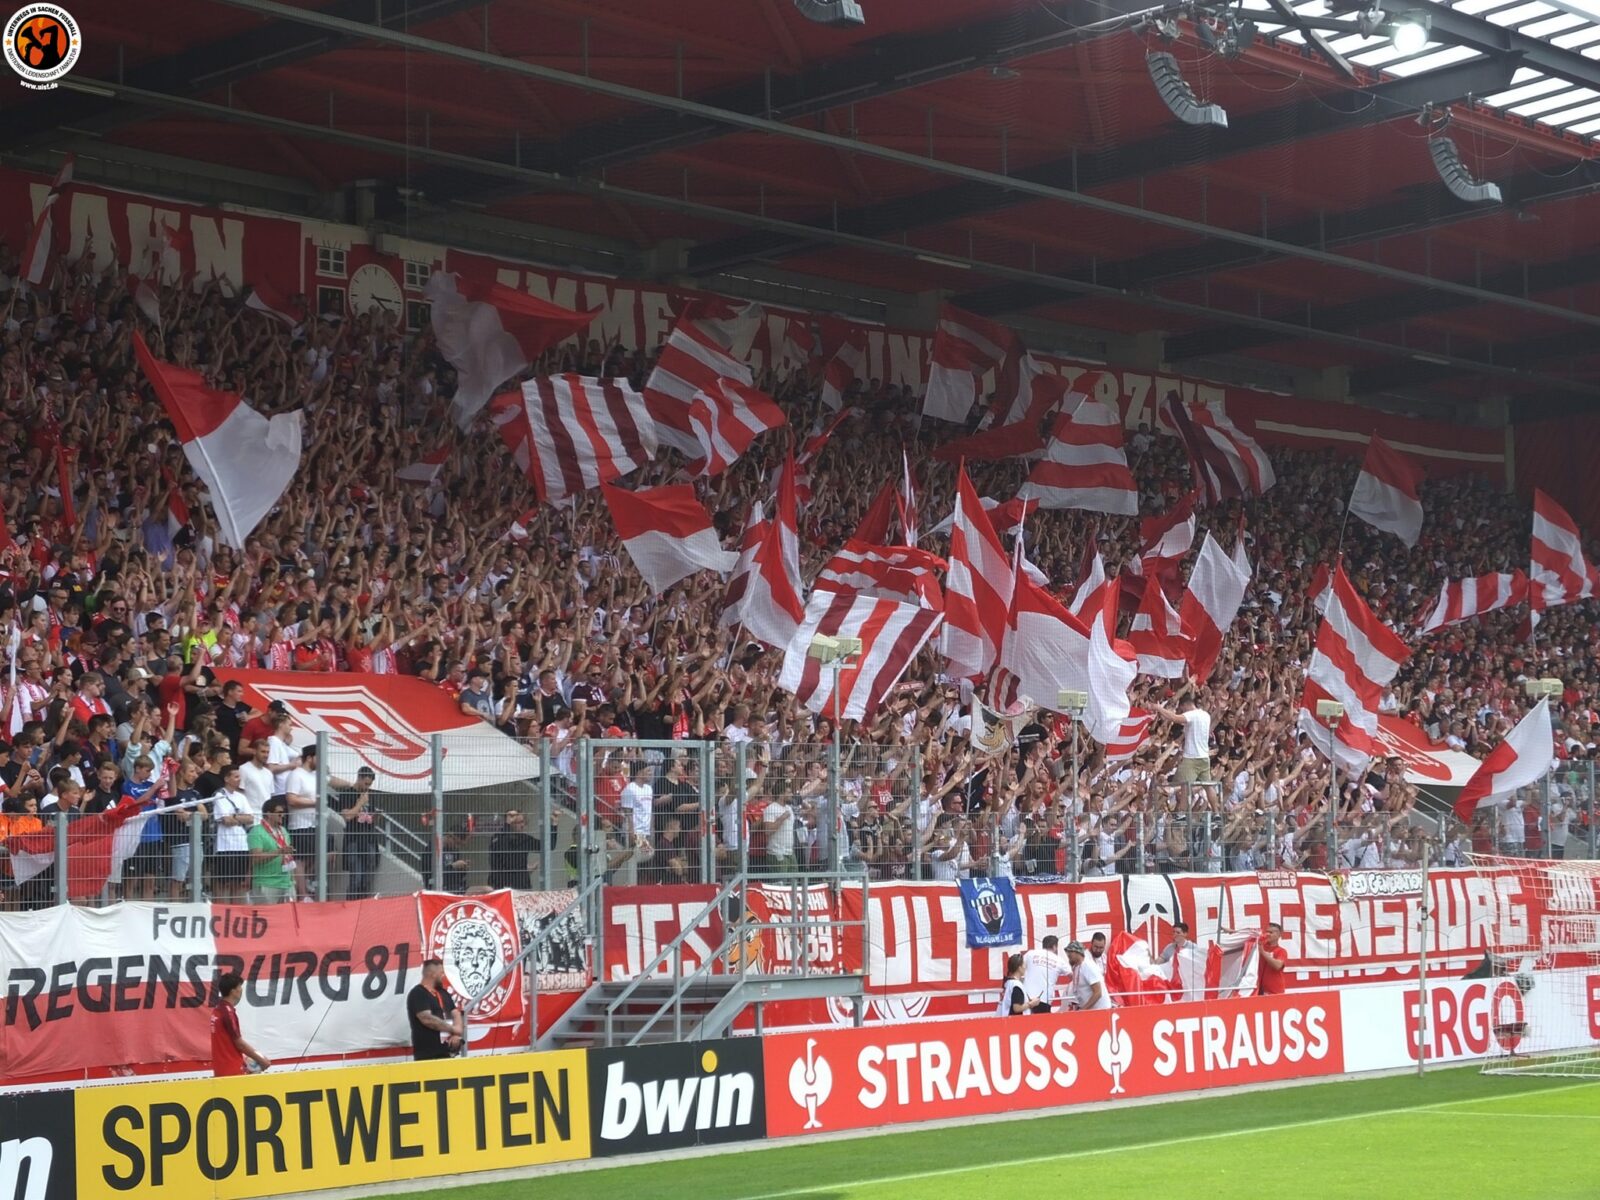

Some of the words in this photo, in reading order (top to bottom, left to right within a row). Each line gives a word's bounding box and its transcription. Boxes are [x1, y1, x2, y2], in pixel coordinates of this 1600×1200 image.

[29, 183, 245, 298] AHN
[152, 907, 268, 941] Fanclub
[5, 949, 353, 1032] REGENSBURG
[361, 942, 410, 1001] 81
[523, 972, 587, 991] RGENSBURG
[1402, 980, 1526, 1061] ERGO
[857, 1028, 1079, 1109] STRAUSS
[1153, 1005, 1329, 1077] STRAUSS
[101, 1067, 572, 1191] SPORTWETTEN
[601, 1050, 755, 1140] bwin
